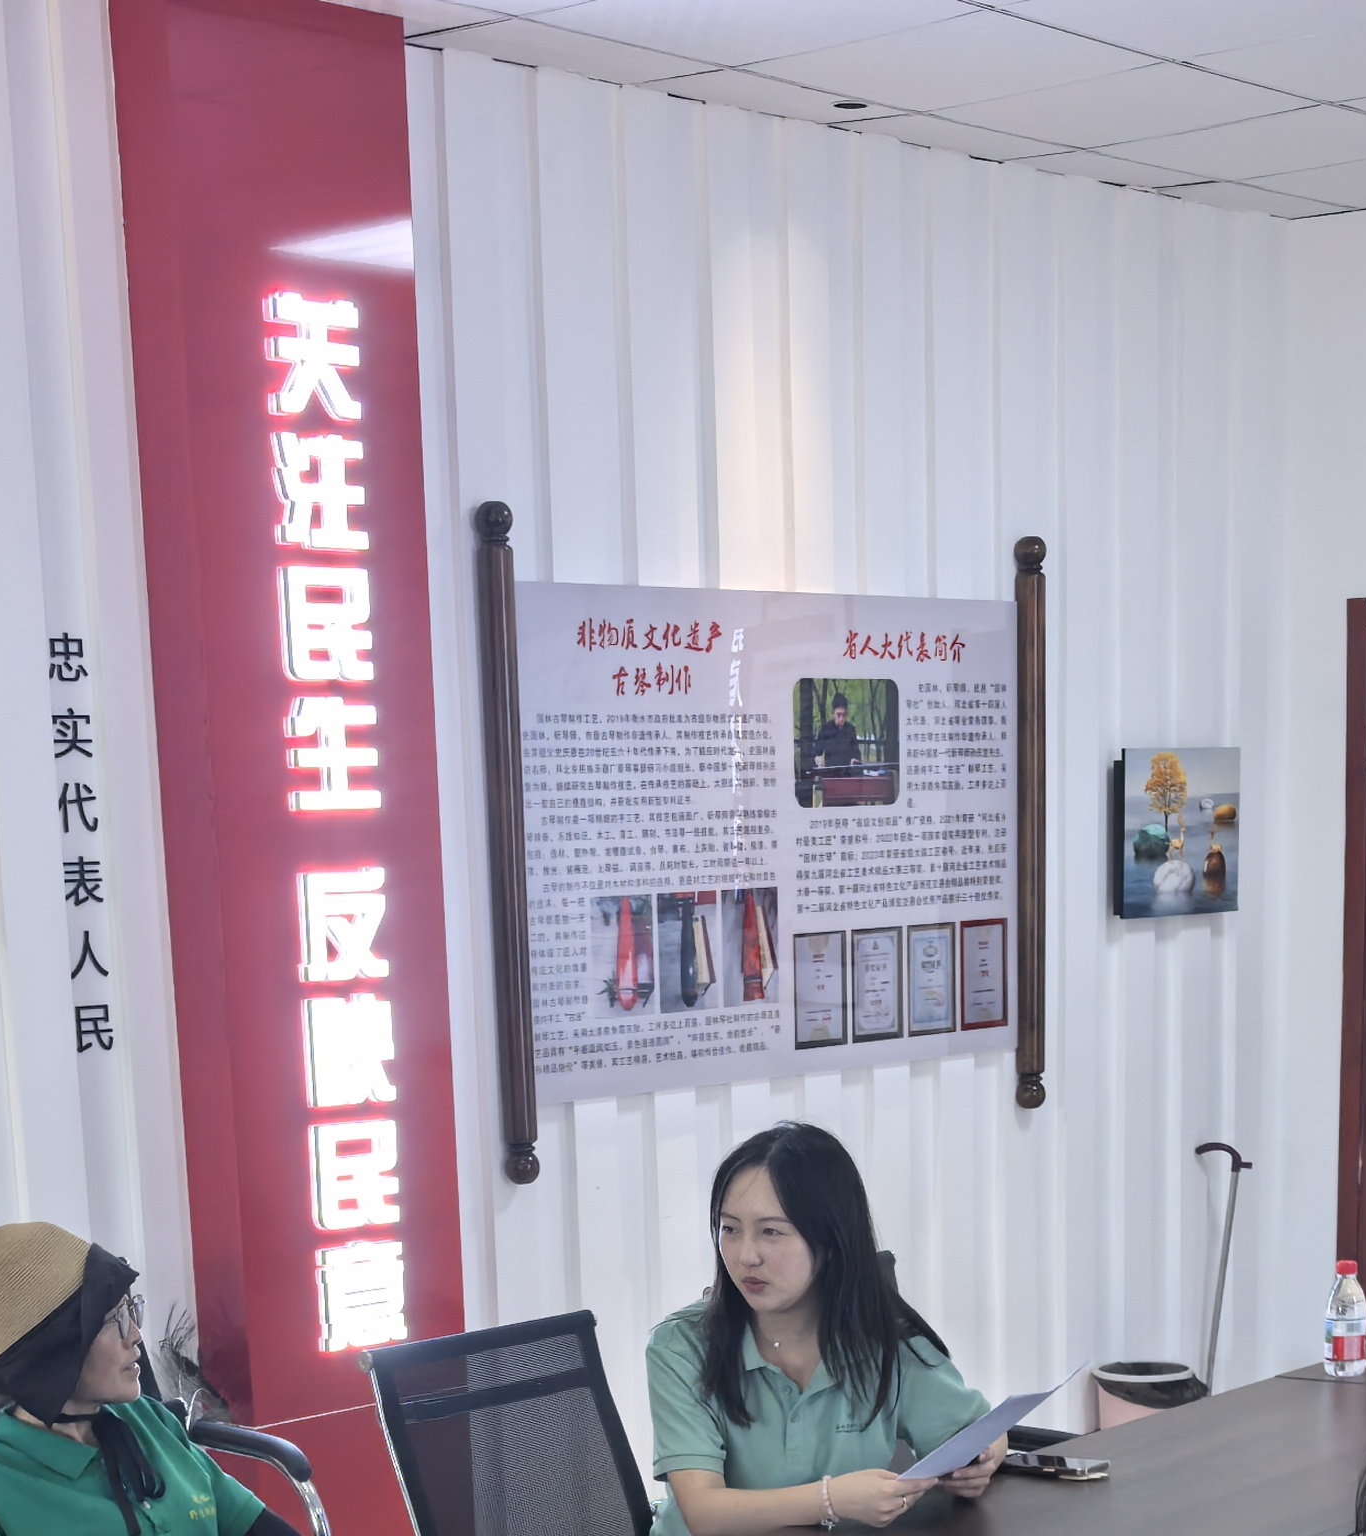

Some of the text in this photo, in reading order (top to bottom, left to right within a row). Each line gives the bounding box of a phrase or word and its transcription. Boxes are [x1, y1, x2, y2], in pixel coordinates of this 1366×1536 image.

[576, 617, 722, 653] 非物质文化遗产
[842, 629, 966, 663] 省人大代表简介
[612, 662, 692, 697] 古琴制作
[48, 631, 115, 1054] 忠实代表人民
